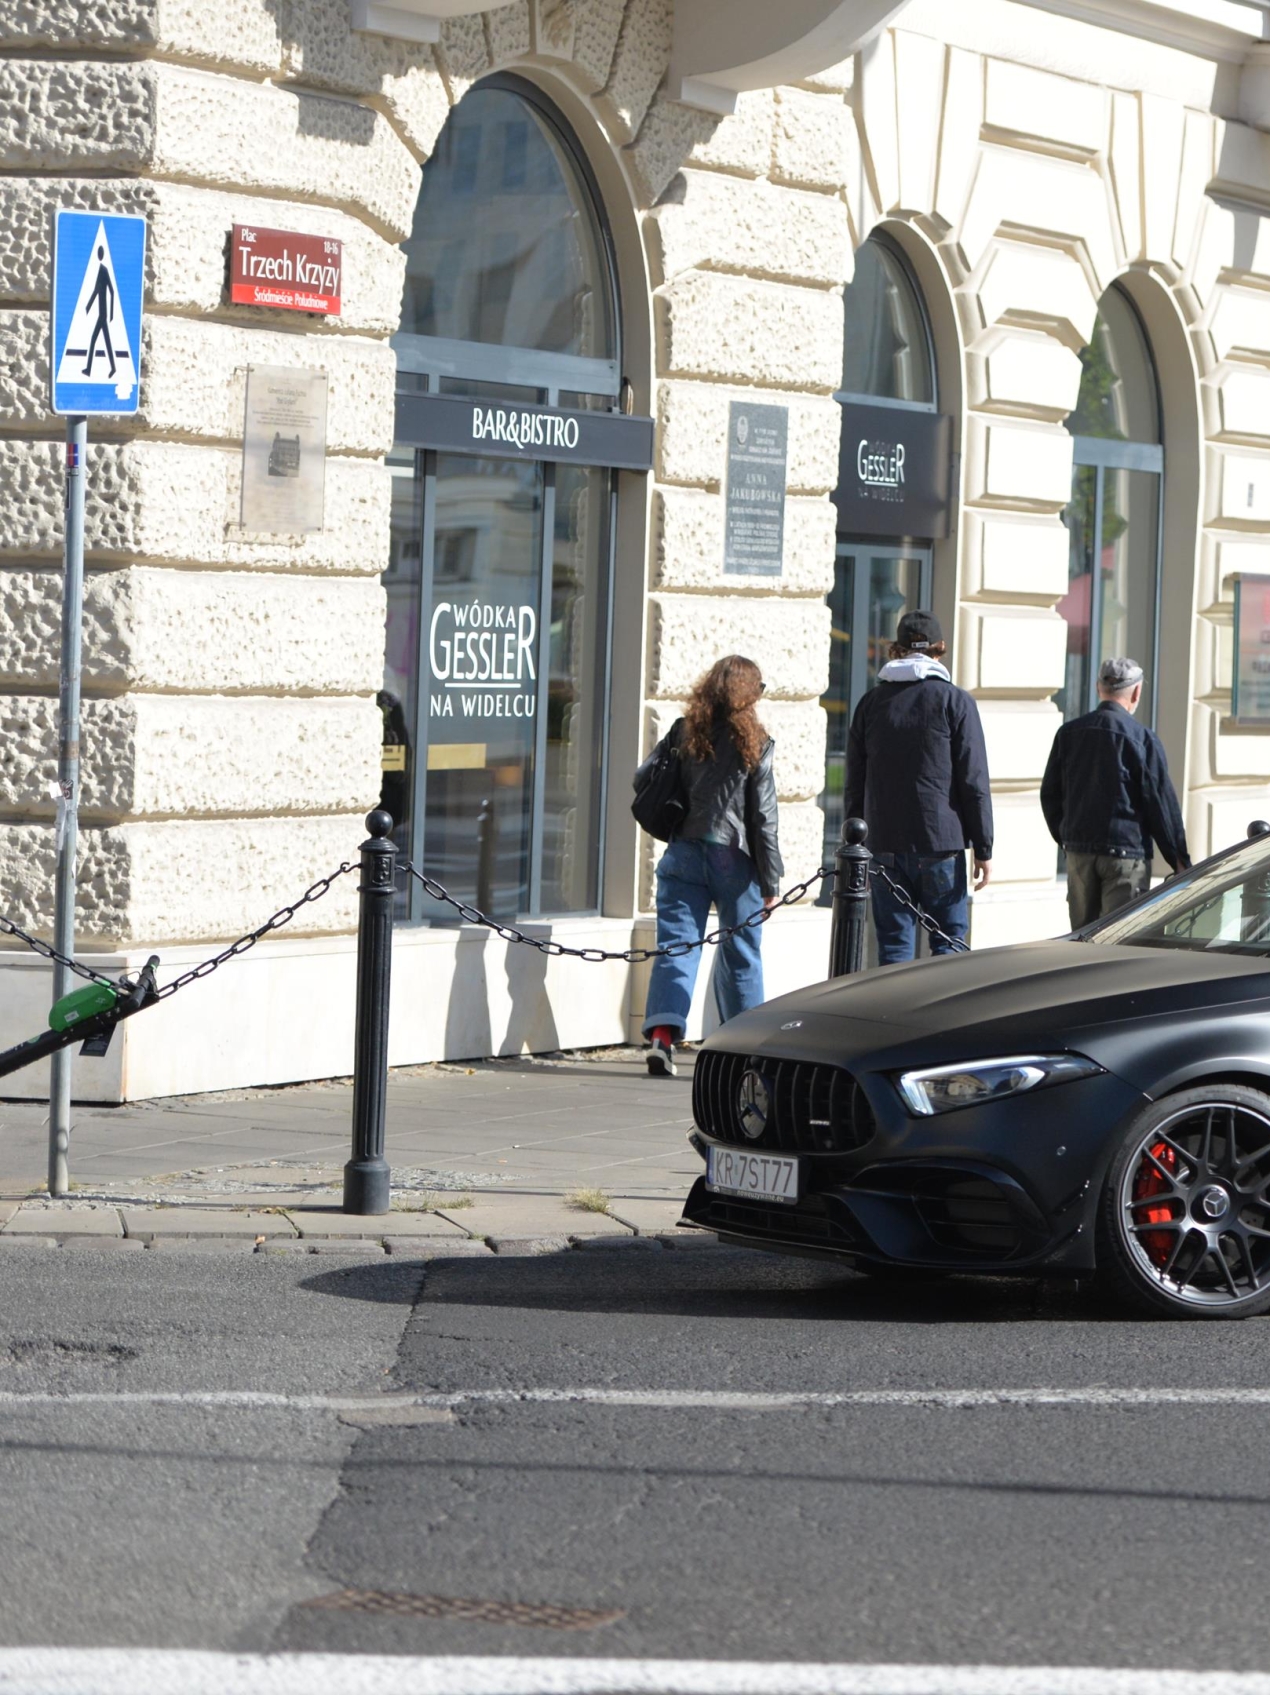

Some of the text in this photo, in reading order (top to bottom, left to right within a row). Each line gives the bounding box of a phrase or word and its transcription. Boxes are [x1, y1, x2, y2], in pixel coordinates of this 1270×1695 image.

[241, 228, 257, 243] Plac
[239, 246, 340, 297] Trzech Krzyży
[254, 286, 329, 310] Śródmieście Południowe
[472, 407, 579, 449] BAR&BISTRO
[452, 599, 517, 628] WÓDKA
[430, 694, 536, 717] NA WIDELCU
[716, 1151, 794, 1194] KR 7ST77
